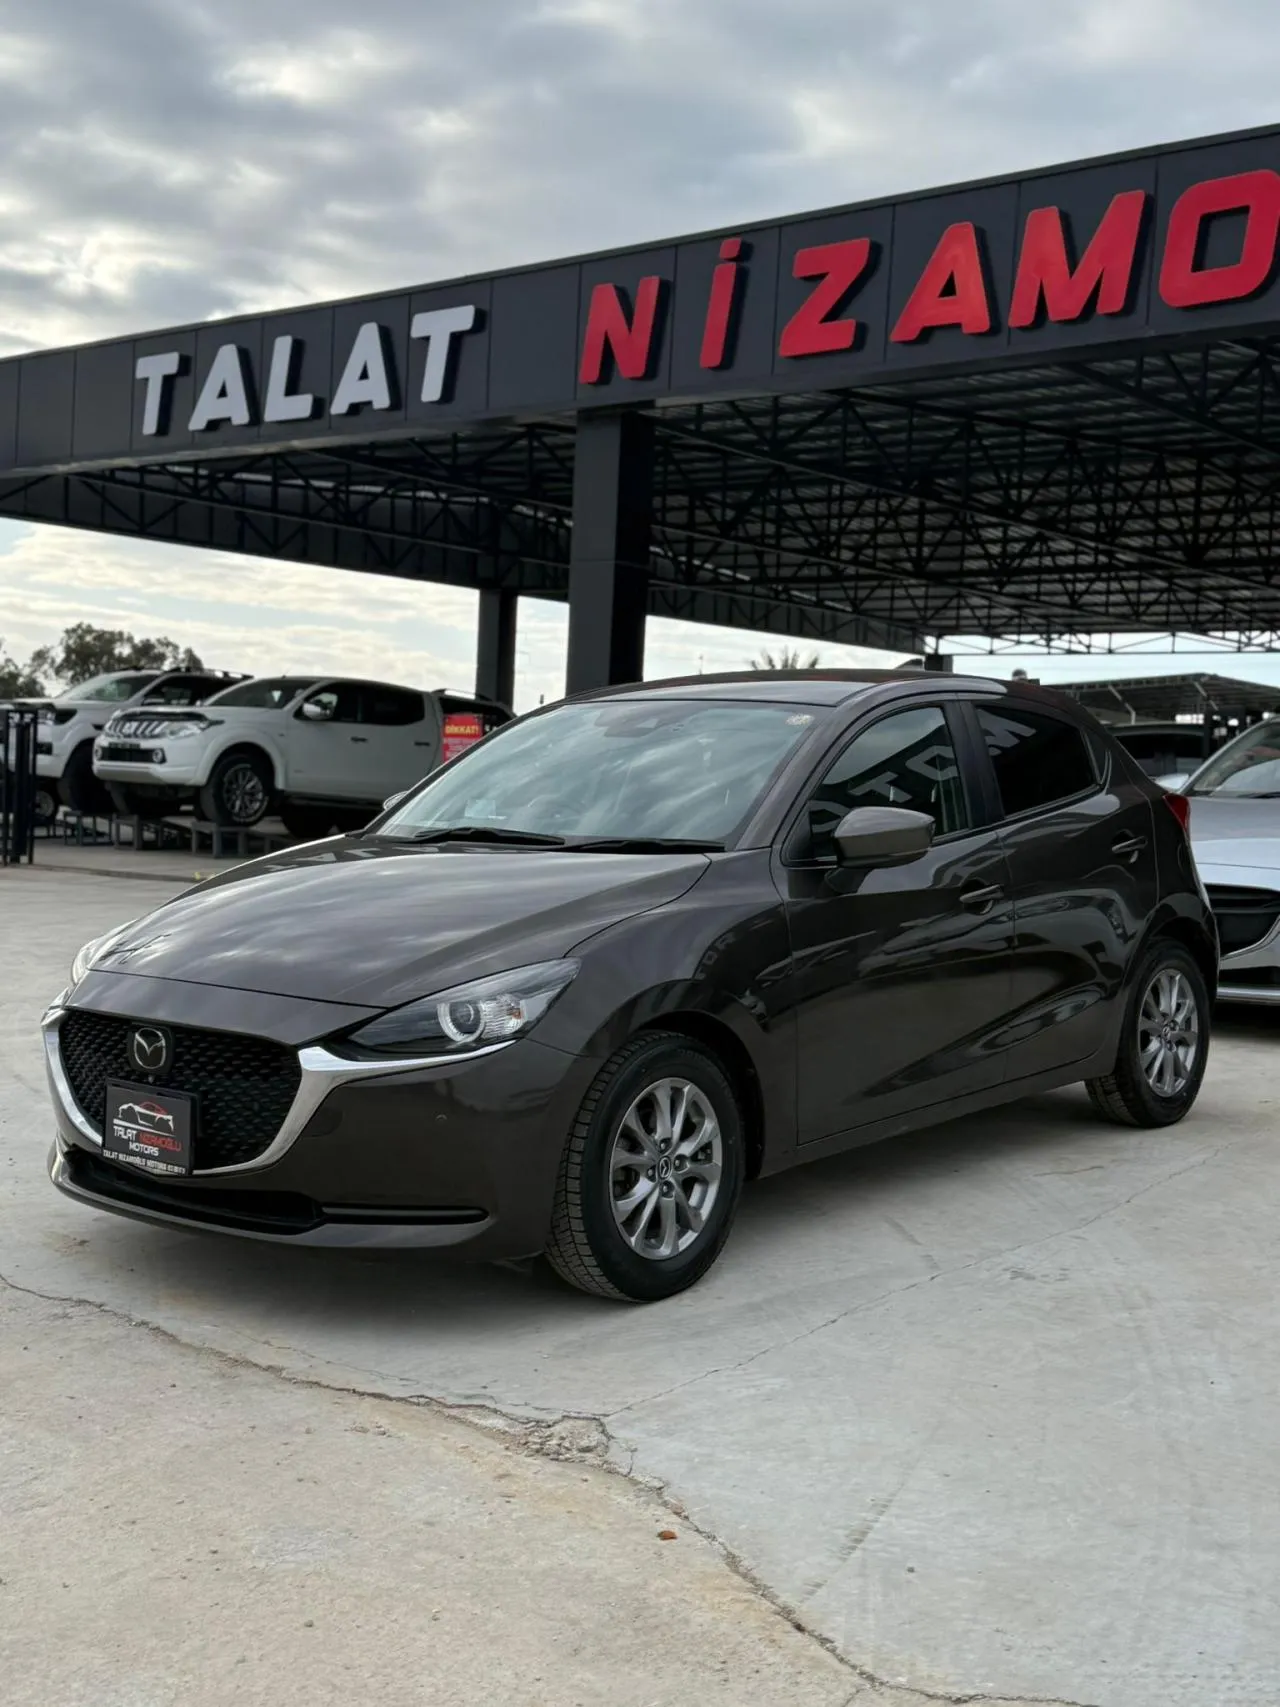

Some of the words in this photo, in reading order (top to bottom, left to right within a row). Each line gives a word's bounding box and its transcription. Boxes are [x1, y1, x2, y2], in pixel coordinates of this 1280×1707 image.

[136, 305, 475, 434] TALAT
[579, 169, 1280, 384] NİZAMO
[113, 1126, 137, 1141] TALAT
[129, 1142, 159, 1156] MOTORS
